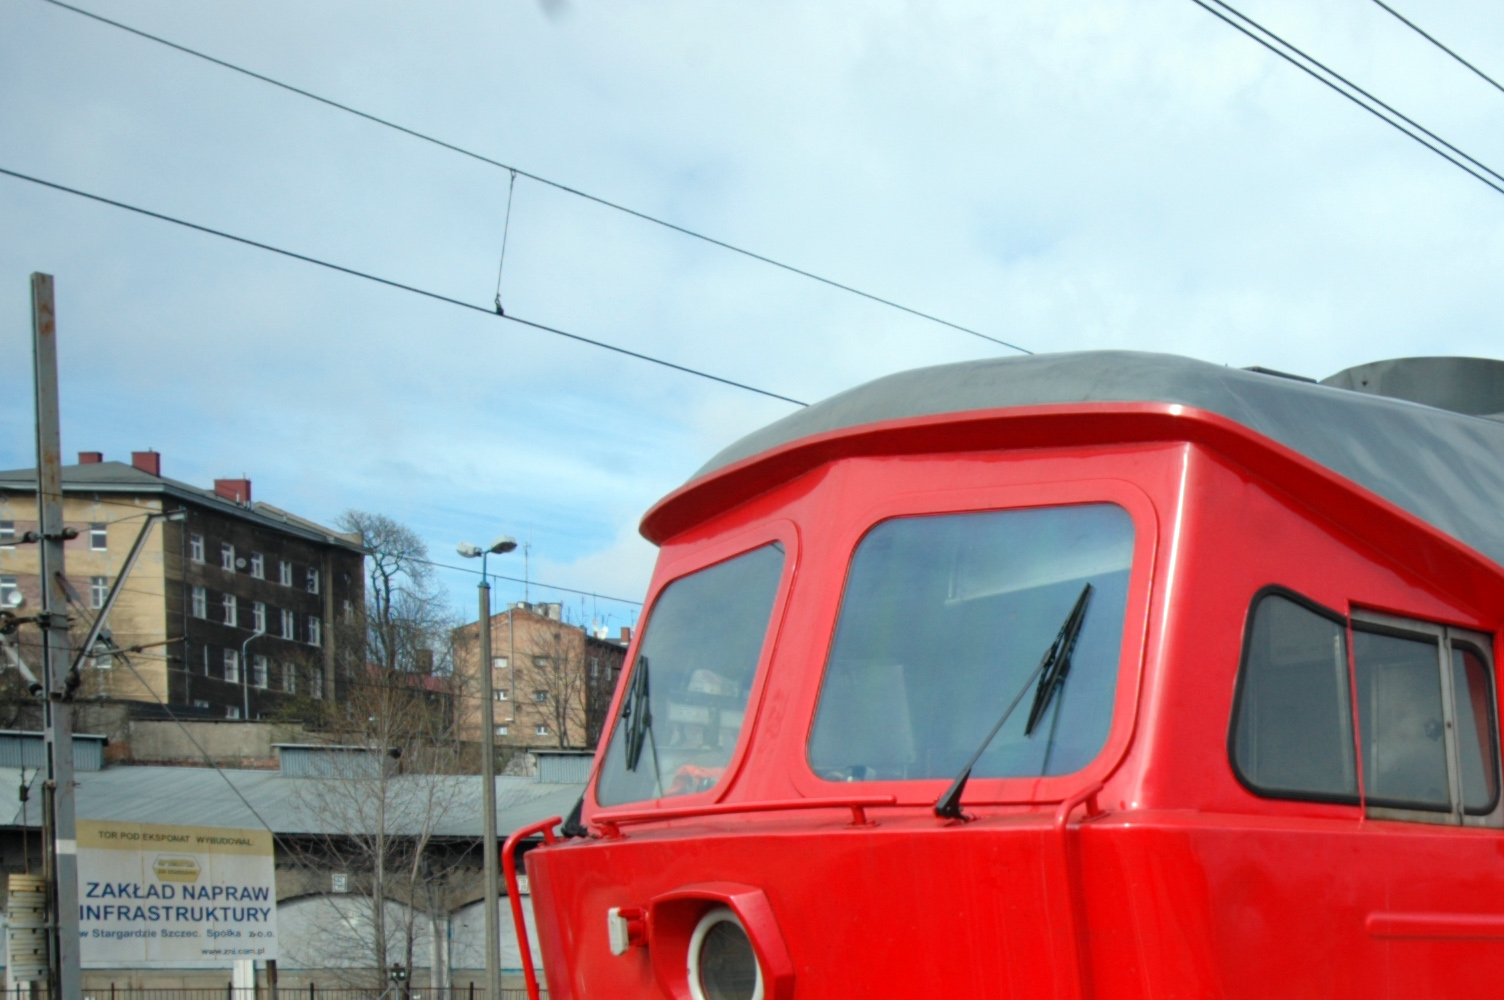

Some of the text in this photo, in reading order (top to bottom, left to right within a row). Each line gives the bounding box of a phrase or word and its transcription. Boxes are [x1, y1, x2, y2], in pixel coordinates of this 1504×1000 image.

[98, 831, 118, 839] TOR
[120, 832, 140, 840] POD
[86, 882, 269, 901] ZAKŁAD NAPRAW
[80, 904, 271, 922] INFRASTRUKTURY
[92, 928, 157, 939] Stargardzie
